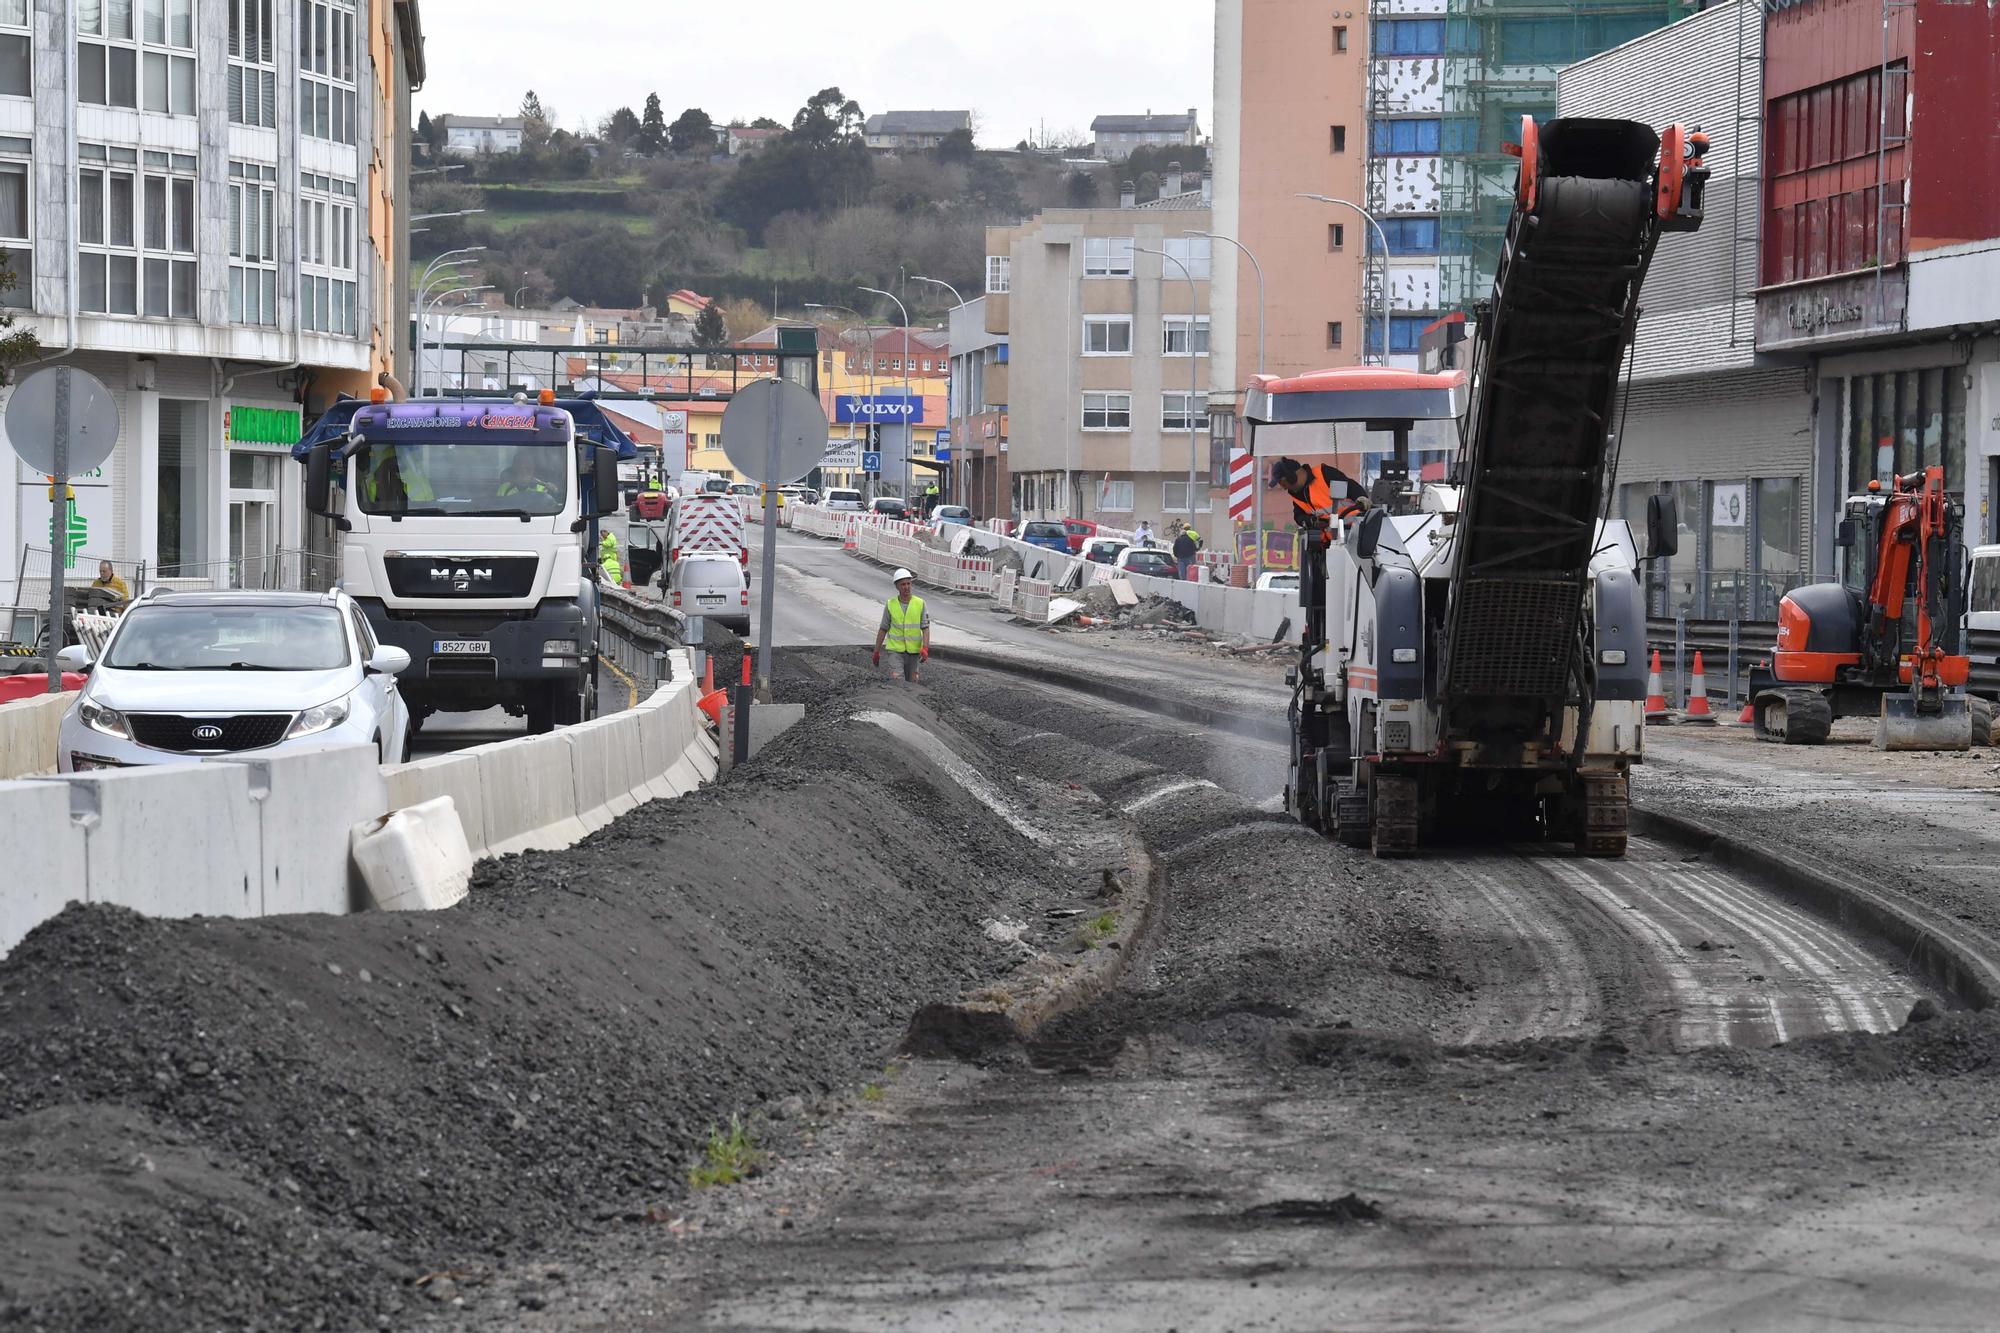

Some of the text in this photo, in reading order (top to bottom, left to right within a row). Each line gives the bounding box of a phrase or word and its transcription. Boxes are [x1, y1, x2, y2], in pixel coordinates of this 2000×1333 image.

[846, 404, 914, 415] VOLVO
[387, 416, 461, 429] EXCAVACIONES
[467, 415, 477, 427] J.
[430, 568, 492, 581] MAN
[442, 642, 487, 652] 8527 GBV
[197, 728, 218, 737] KIA
